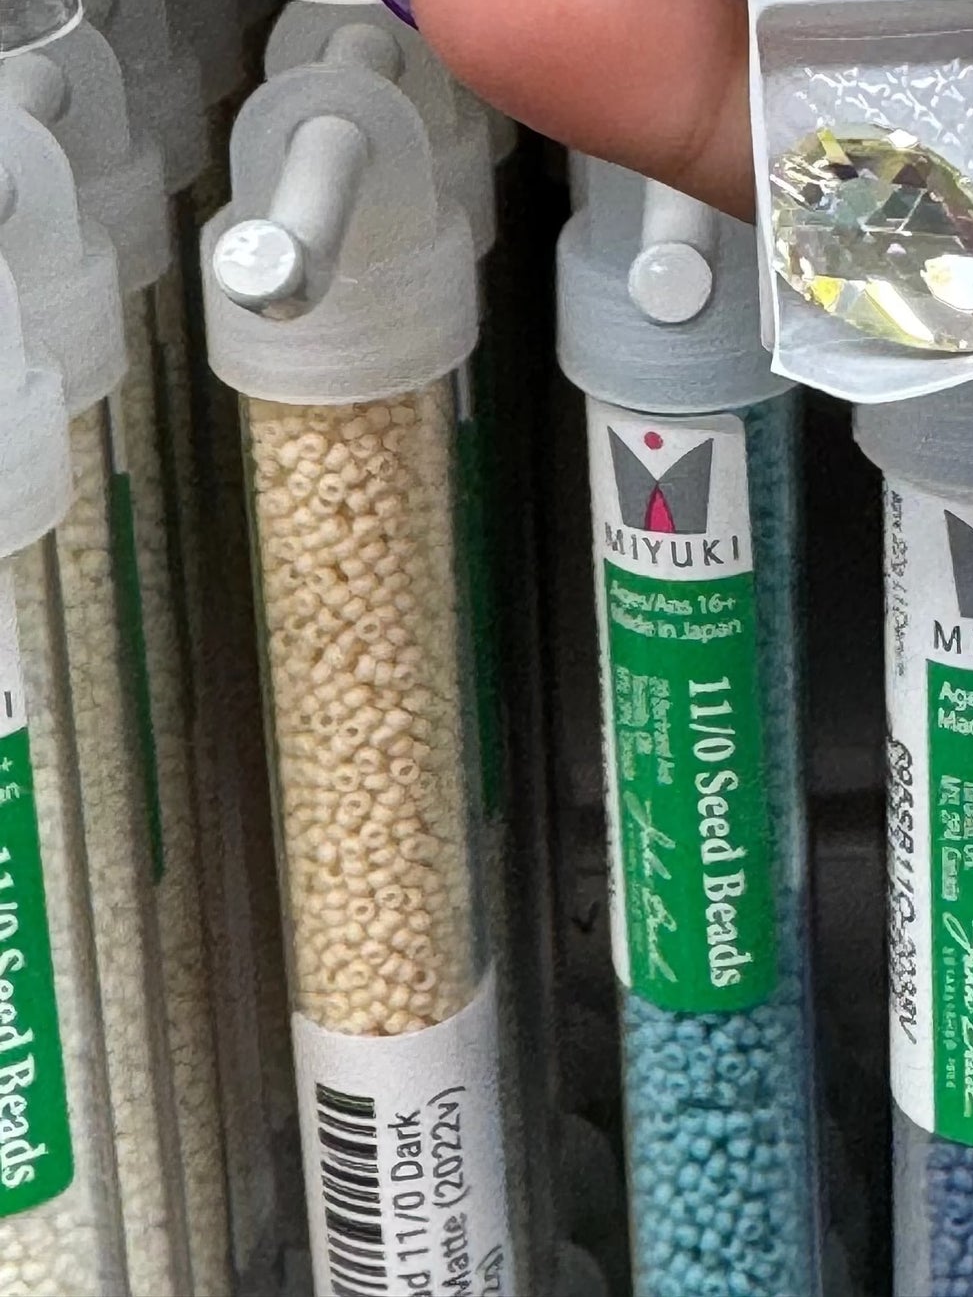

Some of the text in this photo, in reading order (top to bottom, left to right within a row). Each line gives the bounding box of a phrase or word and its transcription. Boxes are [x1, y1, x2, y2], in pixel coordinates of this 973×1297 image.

[604, 521, 739, 568] MIYUKI
[680, 619, 742, 643] Japan
[698, 593, 736, 614] 16+
[688, 676, 752, 988] 11/0 Seed Beads
[387, 1110, 424, 1182] Dark
[426, 1086, 471, 1208] (2022v)
[393, 1191, 430, 1262] 11/0
